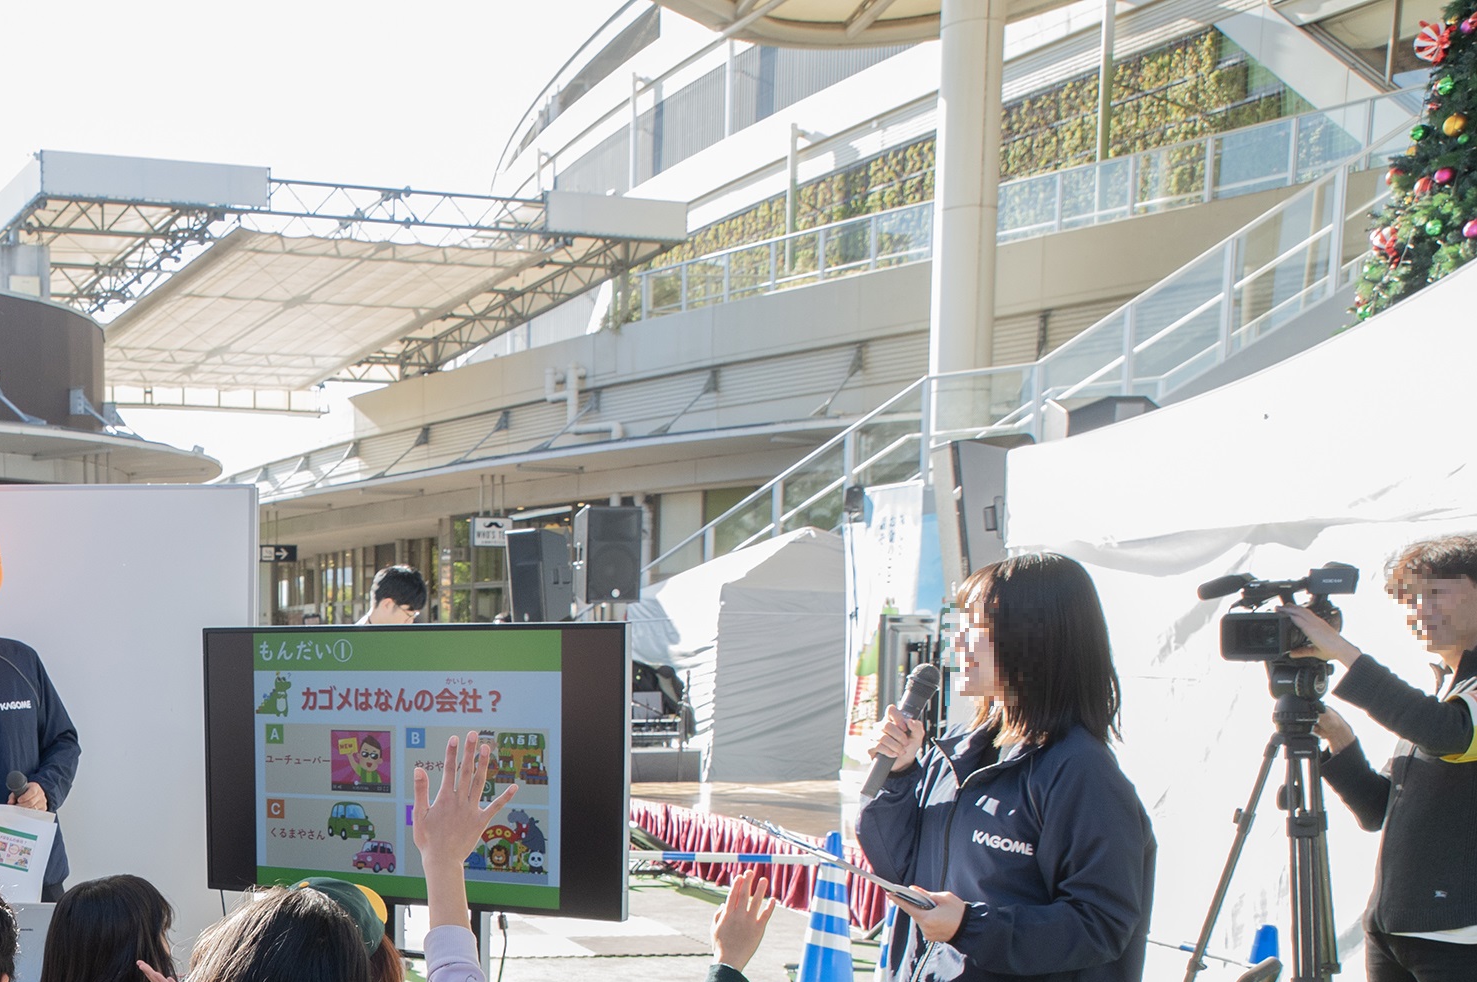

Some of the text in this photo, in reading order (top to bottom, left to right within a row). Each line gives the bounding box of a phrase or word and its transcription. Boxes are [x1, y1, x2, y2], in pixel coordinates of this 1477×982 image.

[259, 638, 353, 663] もんだい①
[445, 677, 474, 686] かいしゃ
[301, 685, 502, 713] カゴメはなんの会社？
[0, 700, 32, 711] KAGOME
[270, 728, 280, 740] A
[411, 732, 420, 745] B
[503, 734, 538, 746] 八百屋
[265, 755, 331, 765] ユーチューバー
[415, 760, 462, 771] やおや
[271, 803, 281, 815] C
[270, 828, 326, 840] くるまやさん
[485, 828, 512, 839] ZOO
[972, 829, 1034, 856] KAGOME
